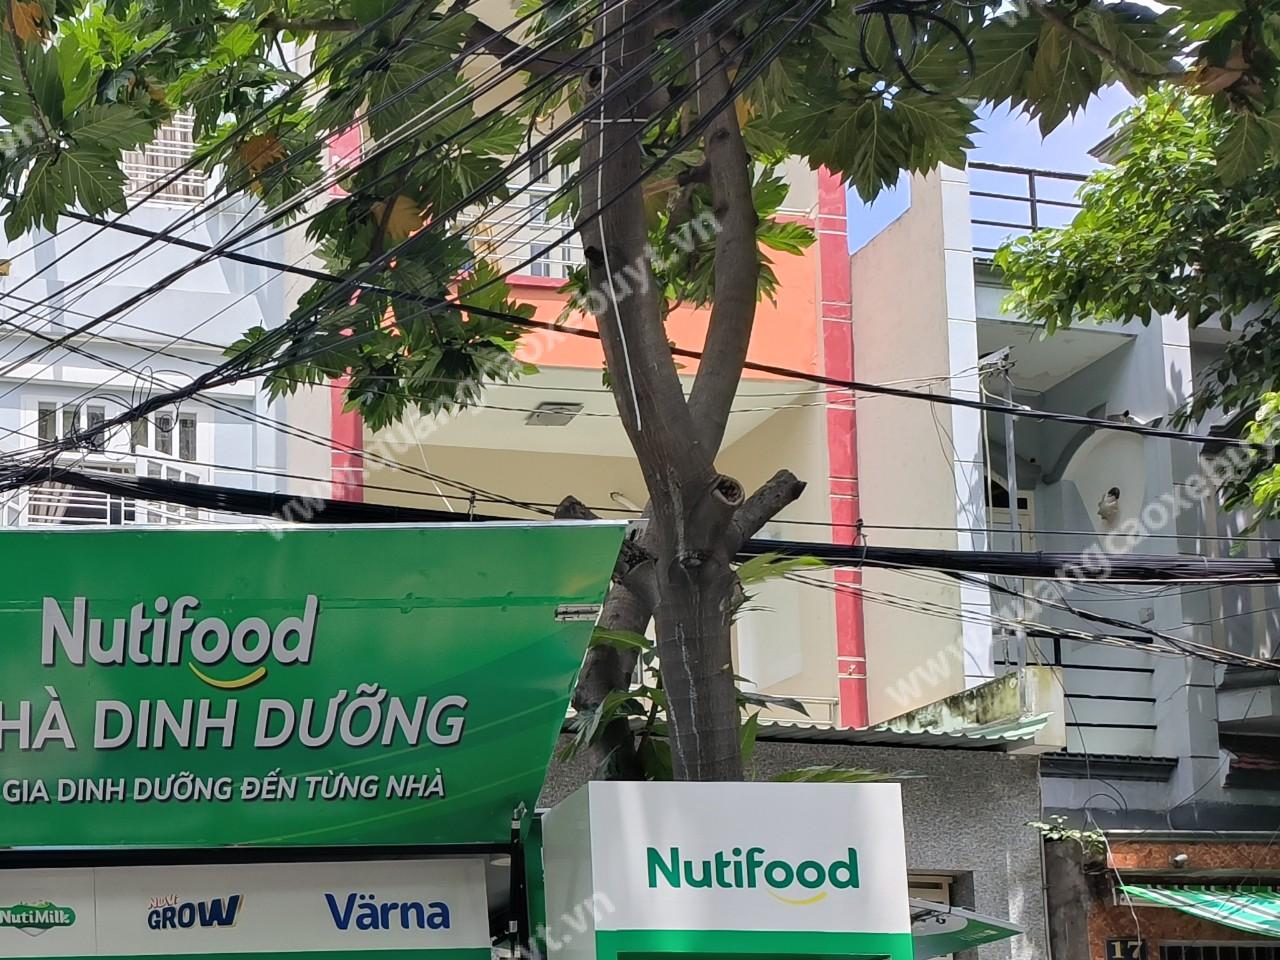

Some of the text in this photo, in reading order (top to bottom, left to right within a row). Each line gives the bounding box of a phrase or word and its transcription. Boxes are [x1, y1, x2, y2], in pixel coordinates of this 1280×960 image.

[41, 594, 319, 667] Nutifood
[94, 699, 238, 749] DINH
[254, 682, 468, 748] DƯỠNG
[2, 779, 50, 803] GIA
[58, 778, 125, 802] DINH
[133, 771, 232, 801] DƯỠNG
[241, 768, 297, 800] ĐẾN
[305, 770, 379, 799] TỪNG
[385, 768, 445, 798] NHÀ
[646, 847, 860, 889] Nutifood
[147, 894, 242, 930] GROW
[325, 892, 451, 930] Värna
[1110, 941, 1143, 959] 17
